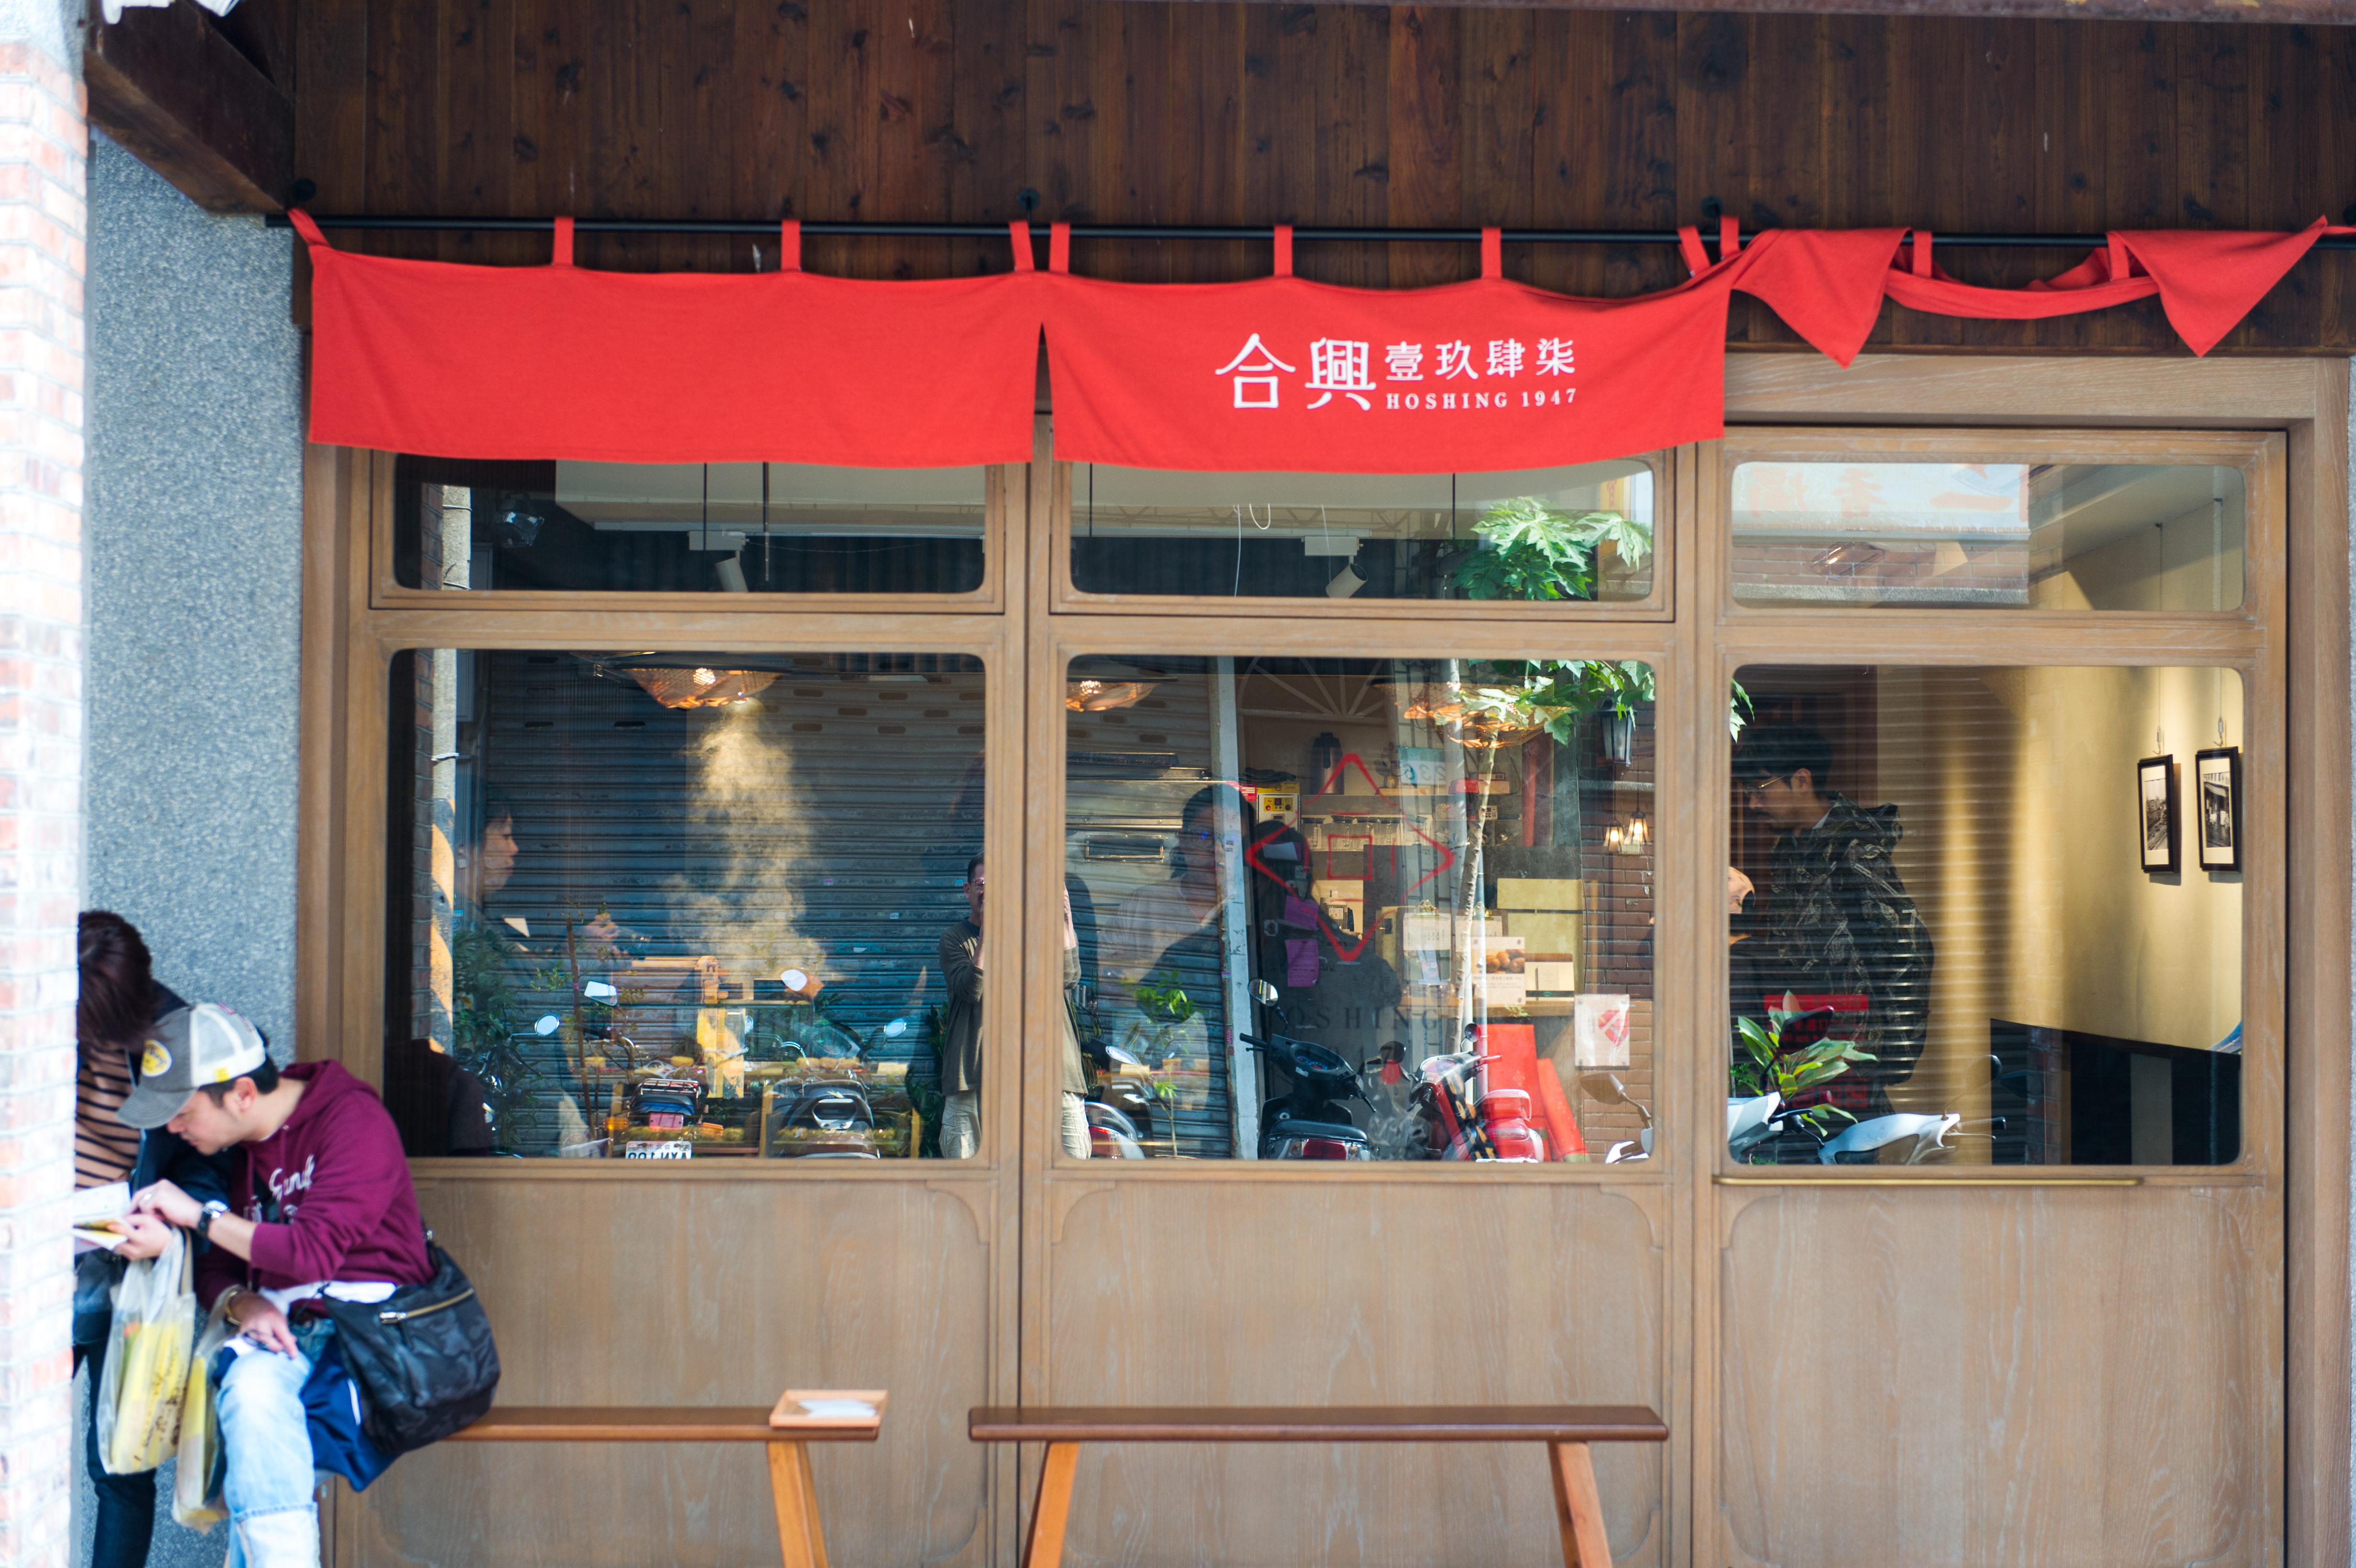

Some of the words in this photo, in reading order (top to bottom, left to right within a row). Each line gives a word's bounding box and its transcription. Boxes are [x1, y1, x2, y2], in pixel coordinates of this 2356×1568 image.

[1215, 333, 1376, 411] 合興
[1385, 337, 1575, 380] 壹玖肆柒
[1386, 392, 1507, 409] HOSHING
[1522, 388, 1576, 407] 1947
[1273, 1007, 1438, 1030] OSHING
